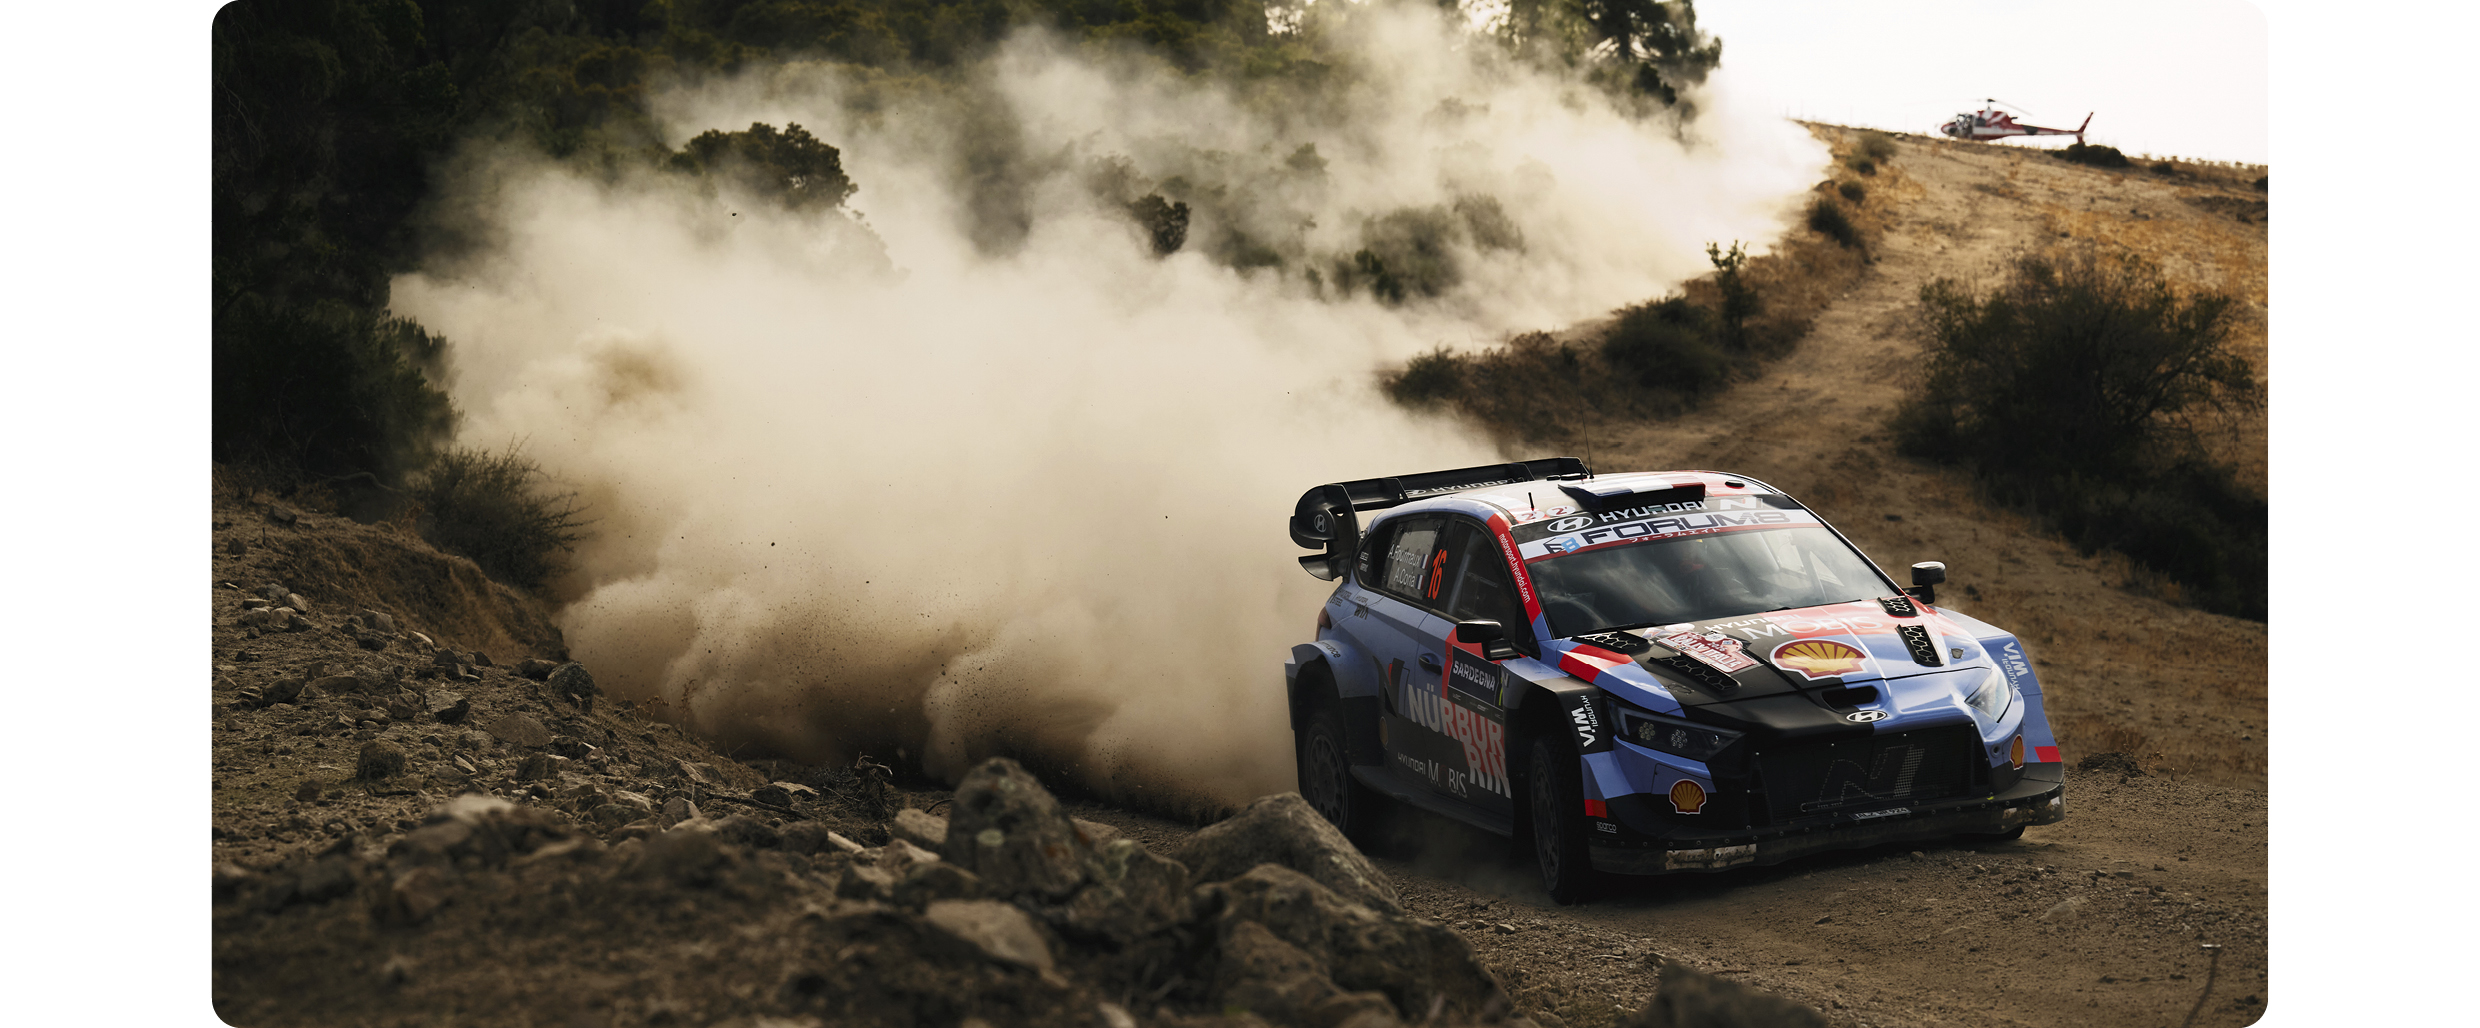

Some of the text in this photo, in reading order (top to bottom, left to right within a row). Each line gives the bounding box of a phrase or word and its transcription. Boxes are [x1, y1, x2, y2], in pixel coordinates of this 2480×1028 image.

[1600, 500, 1708, 522] HYUNDAI
[1581, 511, 1791, 545] FORUM8
[1628, 527, 1721, 543] フォーラムエイト
[1427, 549, 1448, 600] 16
[1499, 533, 1531, 604] motorsport.hyundai.com
[1704, 613, 1801, 634] HYUNDAI
[1738, 616, 1883, 640] MOBIS
[1671, 634, 1710, 652] RALLY
[1702, 648, 1742, 668] ITALIA
[2003, 641, 2029, 677] WIA
[1453, 660, 1496, 691] SARDEGNA
[2001, 659, 2021, 690] HYUNDAI
[1580, 695, 1599, 727] HYUNDAI
[1571, 707, 1596, 747] WIA
[1397, 751, 1426, 775] HYUNDAI
[1596, 821, 1617, 832] sparco
